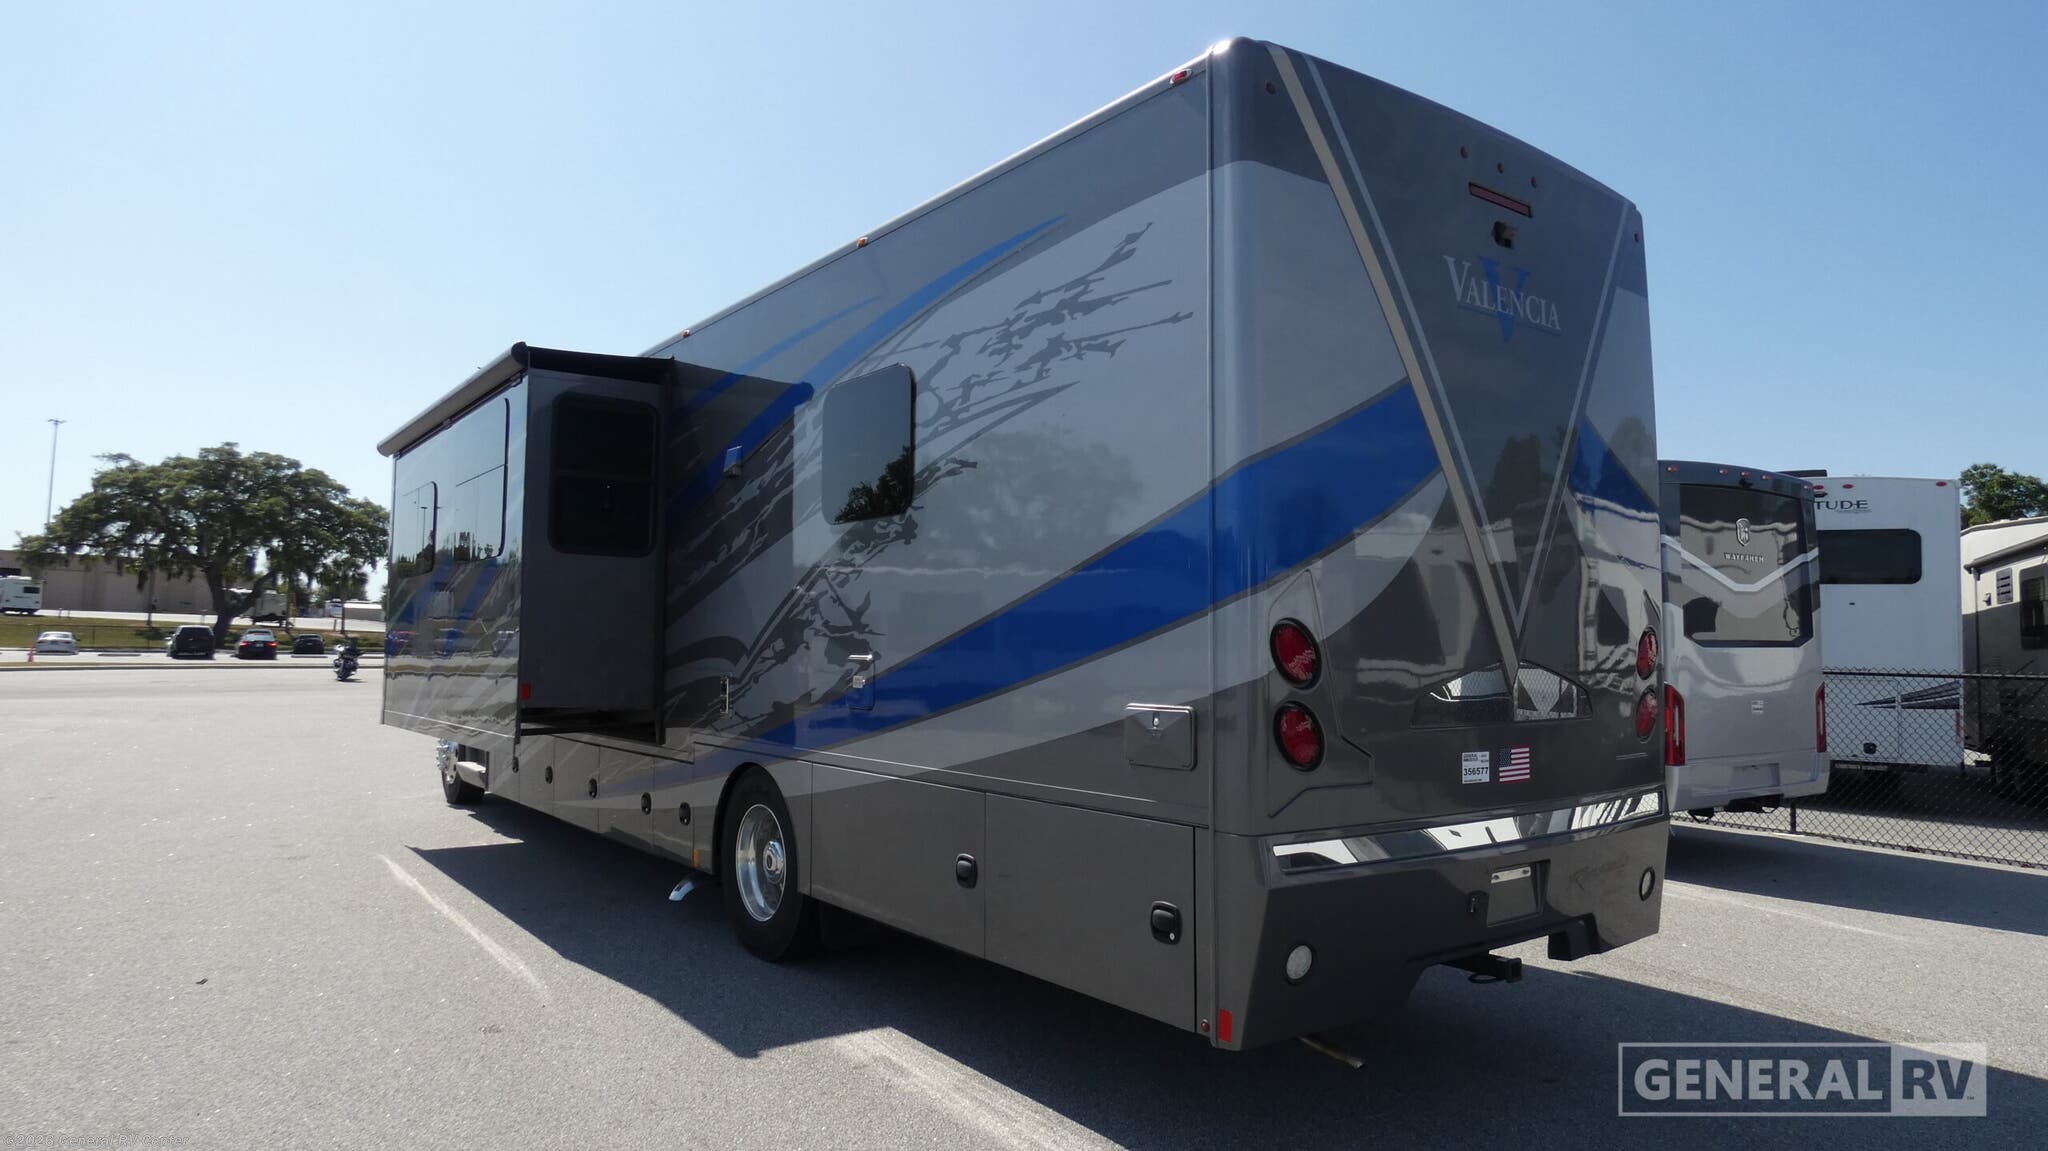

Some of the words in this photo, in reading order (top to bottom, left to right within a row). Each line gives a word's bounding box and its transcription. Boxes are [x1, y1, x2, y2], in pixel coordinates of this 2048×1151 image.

[1442, 254, 1561, 330] VALENCIA
[1813, 499, 1868, 510] TUDE
[1463, 766, 1488, 776] 356577
